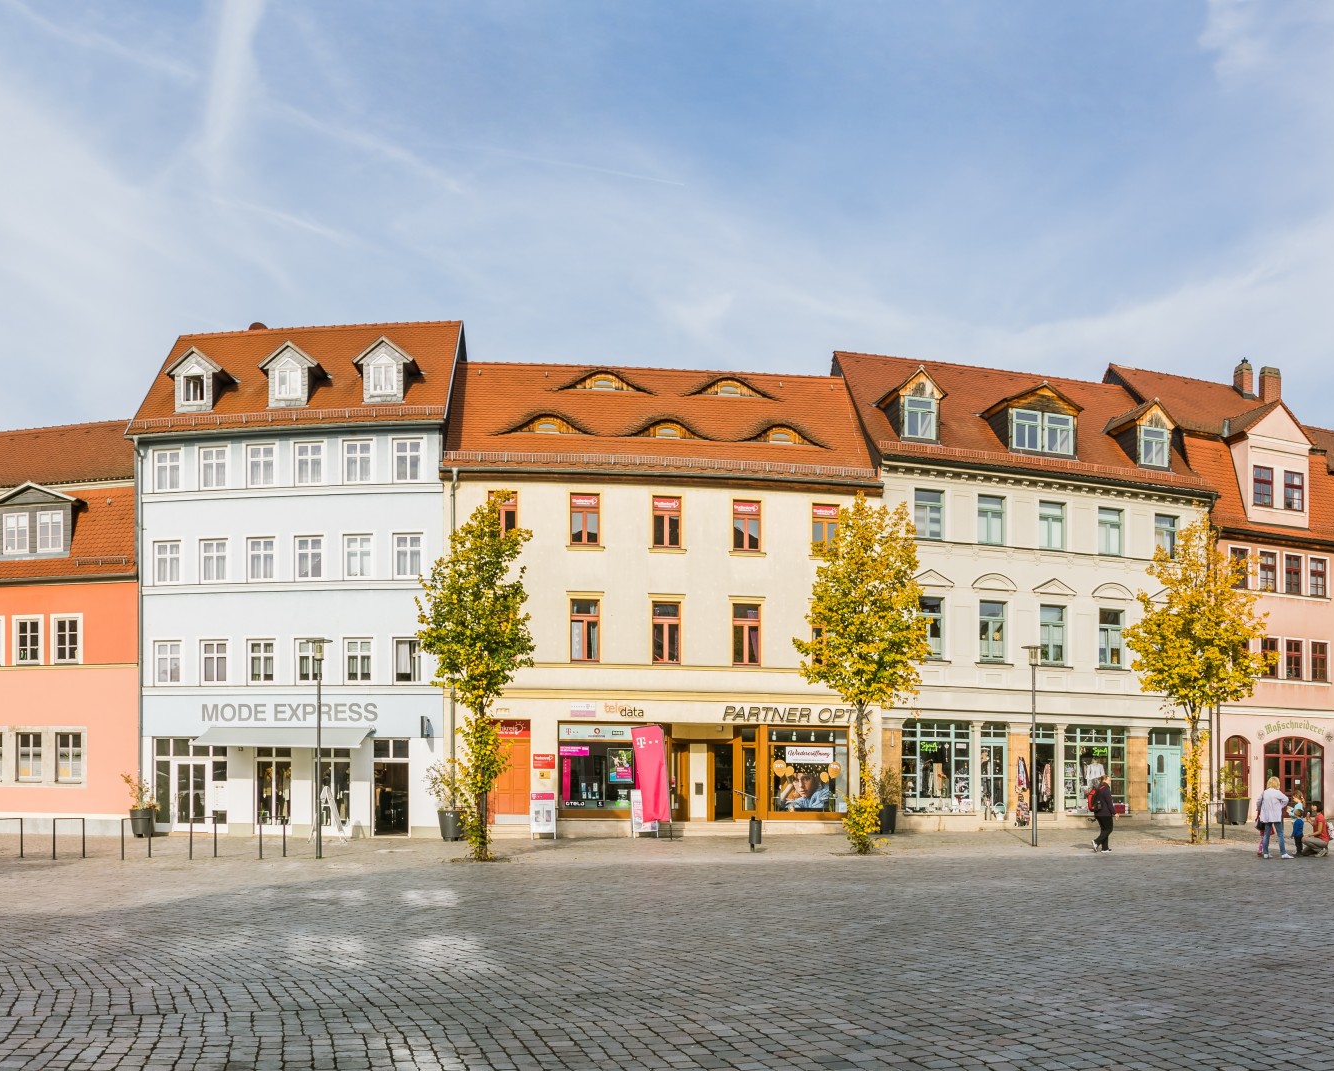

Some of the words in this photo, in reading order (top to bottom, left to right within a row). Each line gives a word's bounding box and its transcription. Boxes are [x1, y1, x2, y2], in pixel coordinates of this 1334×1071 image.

[201, 703, 267, 722] MODE
[273, 702, 379, 722] EXPRESS
[722, 706, 812, 723] PARTNER
[818, 707, 873, 724] OPTK
[1264, 720, 1326, 735] Maßschneiderei
